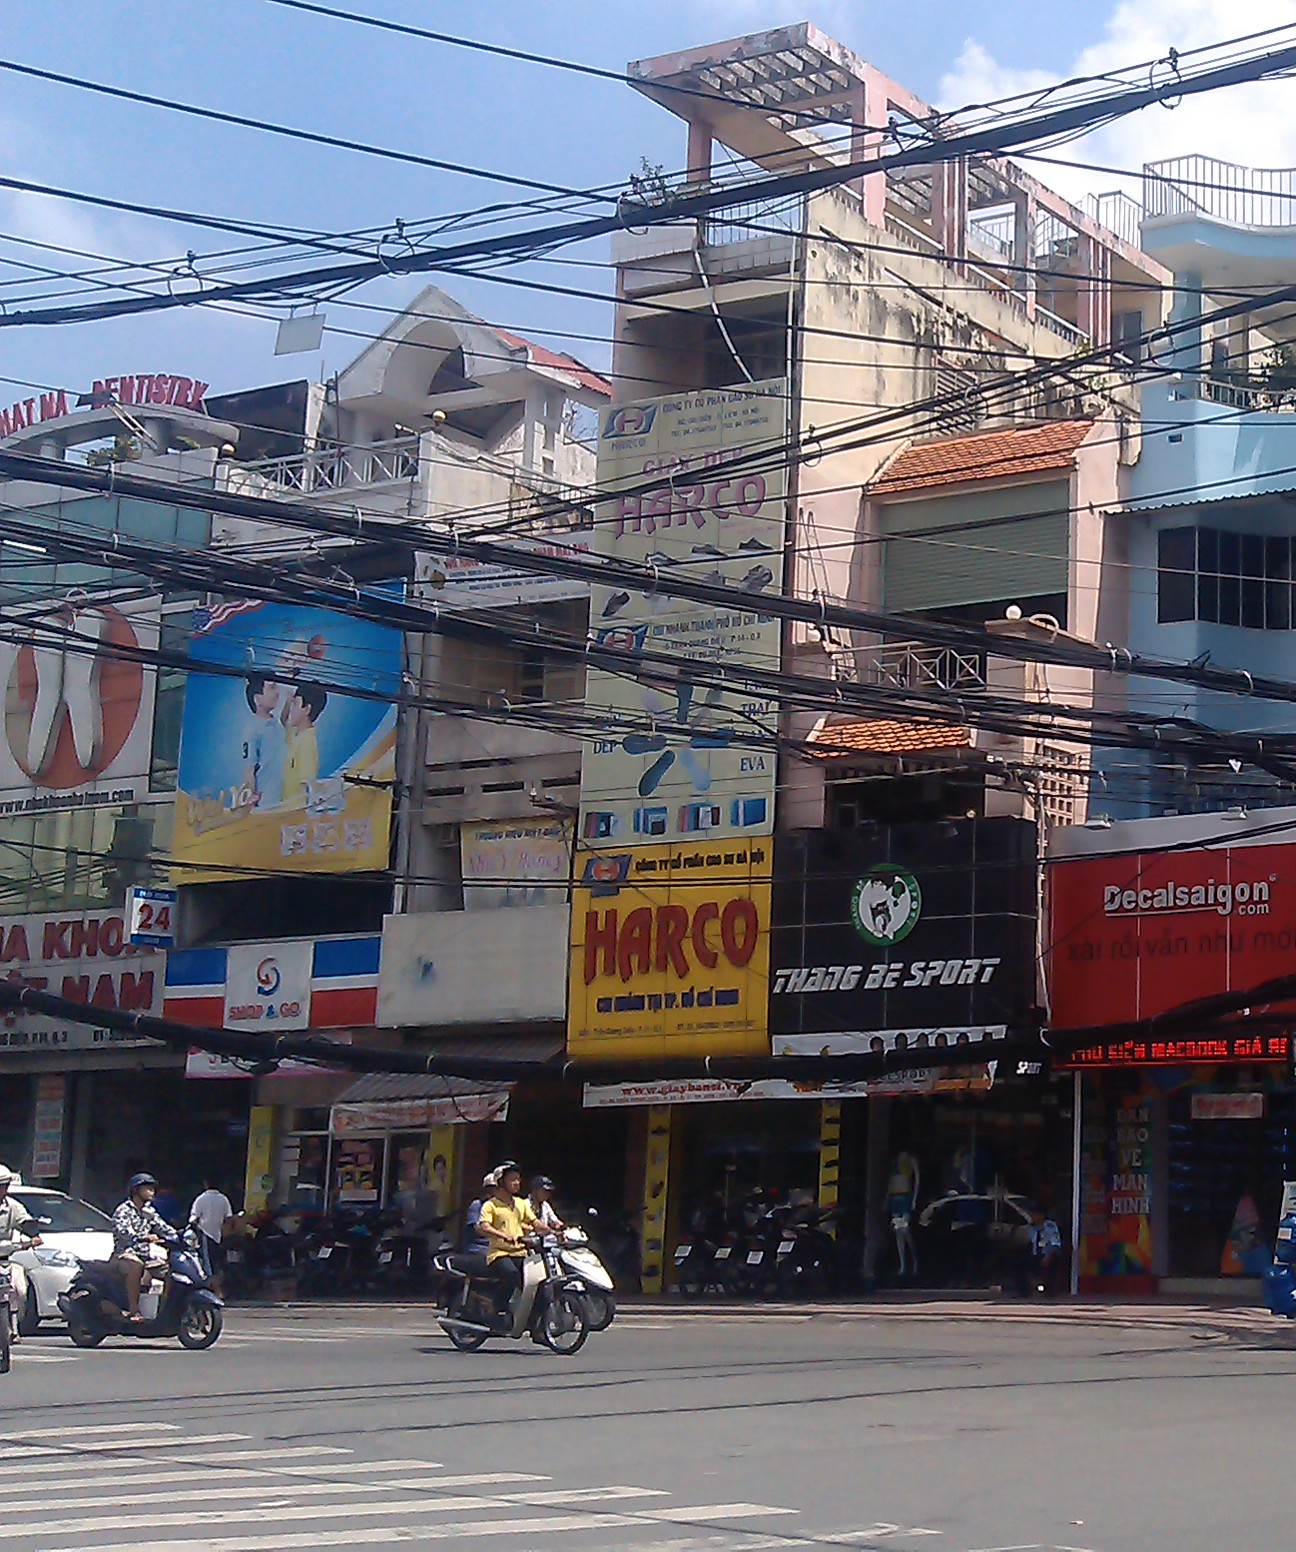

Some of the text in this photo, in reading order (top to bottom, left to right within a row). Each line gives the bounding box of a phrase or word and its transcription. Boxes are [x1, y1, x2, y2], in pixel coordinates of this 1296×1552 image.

[615, 475, 767, 541] HARCO
[740, 756, 765, 772] EVA
[1104, 877, 1270, 916] Decalsaigon
[138, 903, 170, 930] 24
[43, 917, 156, 960] KHO
[583, 898, 759, 986] HARCO
[864, 962, 904, 989] BE
[903, 957, 1001, 988] SPORT
[228, 1002, 301, 1020] SHOP & GO
